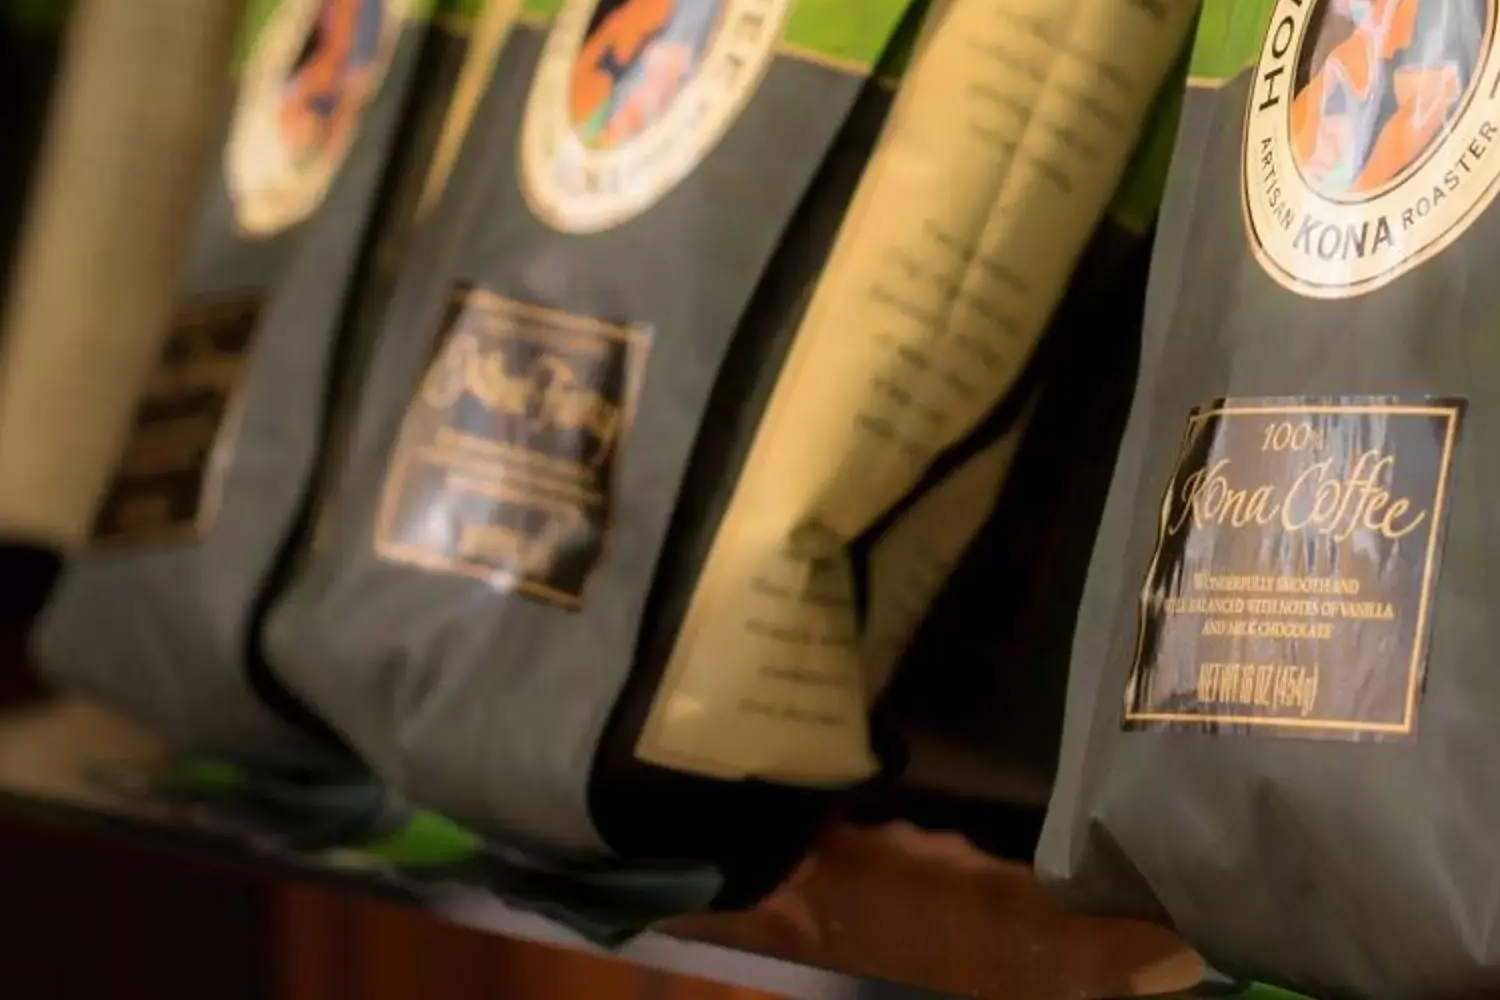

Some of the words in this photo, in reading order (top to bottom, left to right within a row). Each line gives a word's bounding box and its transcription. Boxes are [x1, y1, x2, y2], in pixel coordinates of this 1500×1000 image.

[1259, 136, 1296, 233] ARTISAN
[1293, 213, 1395, 262] KONA
[1400, 119, 1499, 232] ROASTER
[1168, 457, 1281, 536] Kona
[1280, 449, 1427, 543] Coffee
